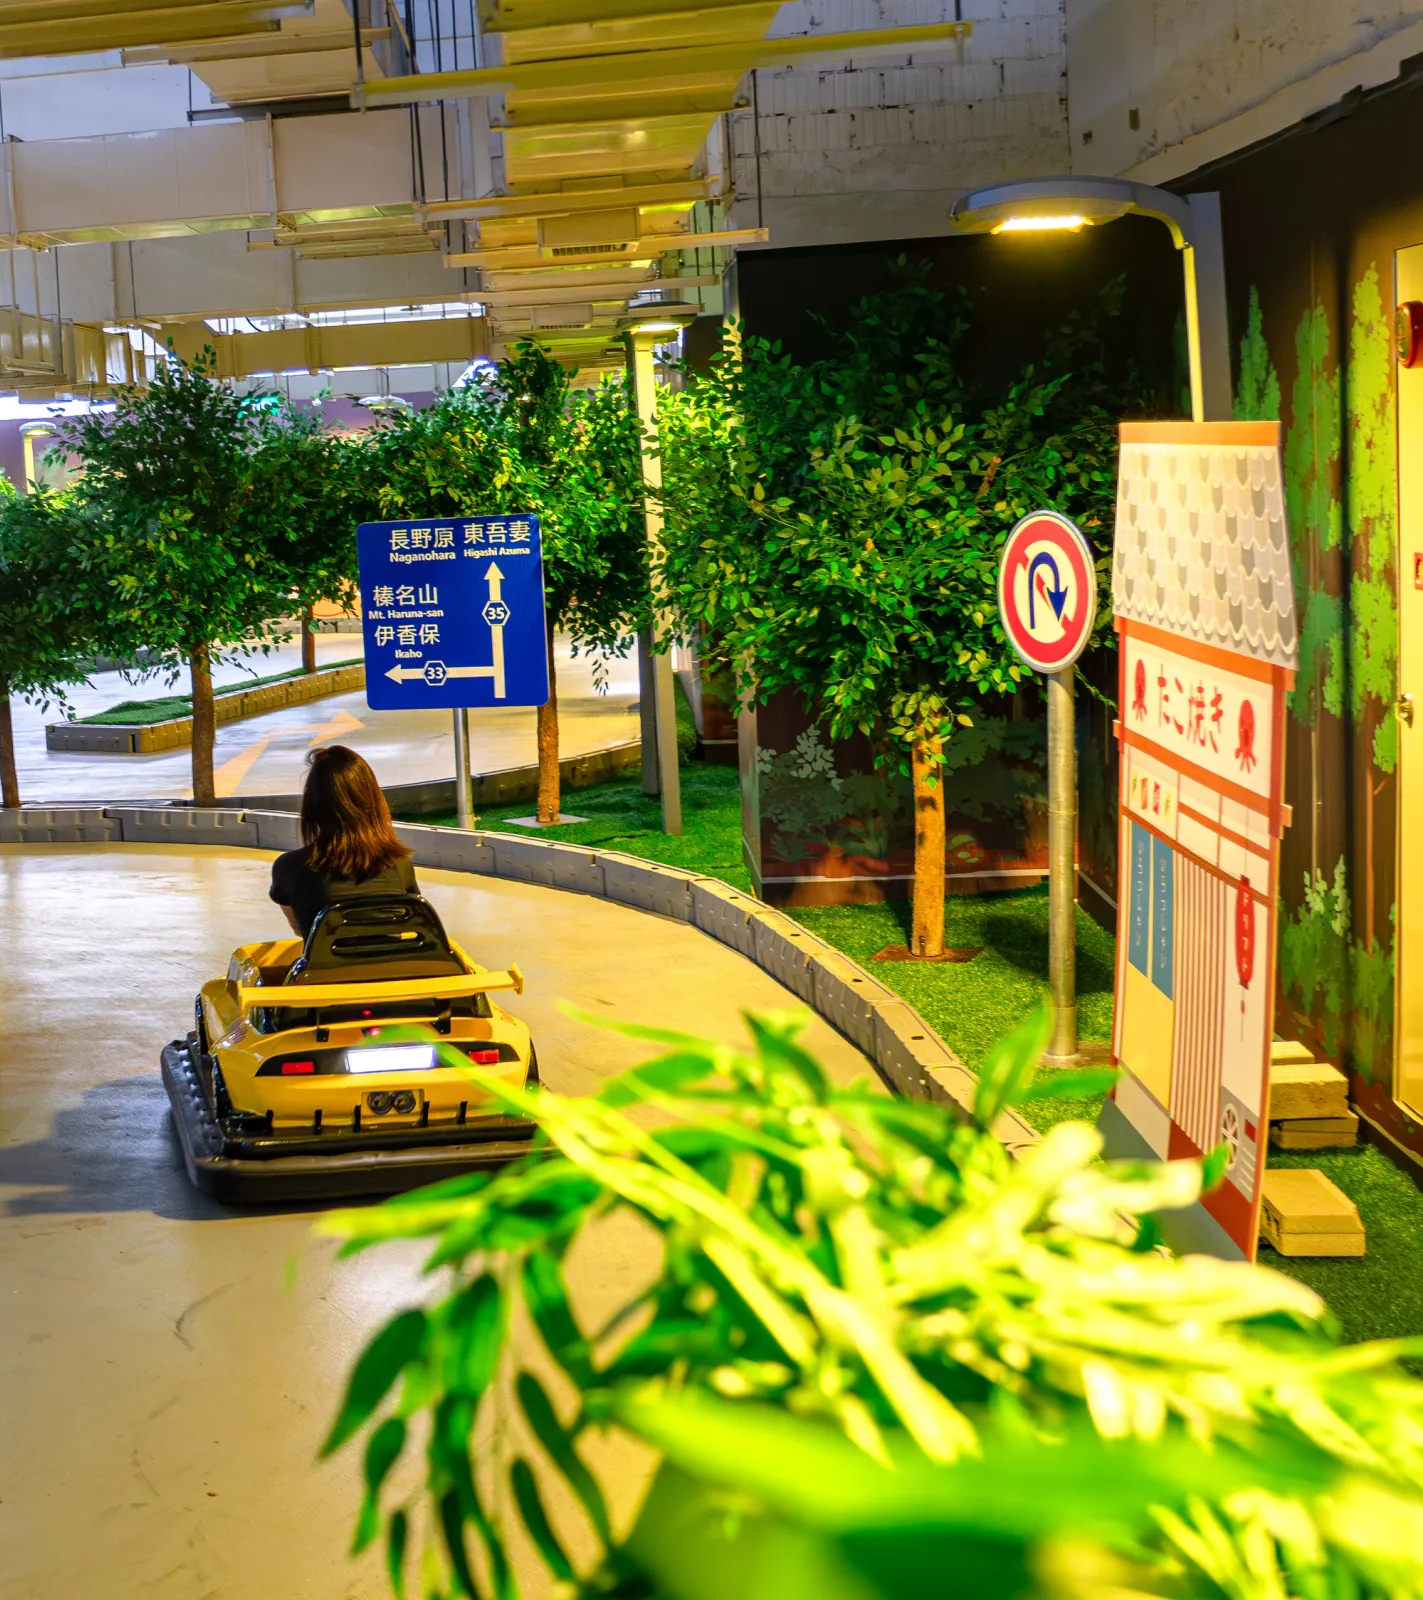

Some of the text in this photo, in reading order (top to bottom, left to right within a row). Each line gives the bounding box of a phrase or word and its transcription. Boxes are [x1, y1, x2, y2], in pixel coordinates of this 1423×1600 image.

[389, 520, 531, 551] 長野原 東吾妻
[389, 546, 530, 564] Naganohara Higashi Azuma
[372, 583, 438, 607] 榛名山
[368, 609, 444, 620] Mt. Haruna-san
[487, 606, 505, 620] 35
[374, 623, 441, 647] 伊香保
[394, 648, 423, 659] Ikaho
[427, 666, 444, 680] 33
[1157, 663, 1224, 754] たこ焼き
